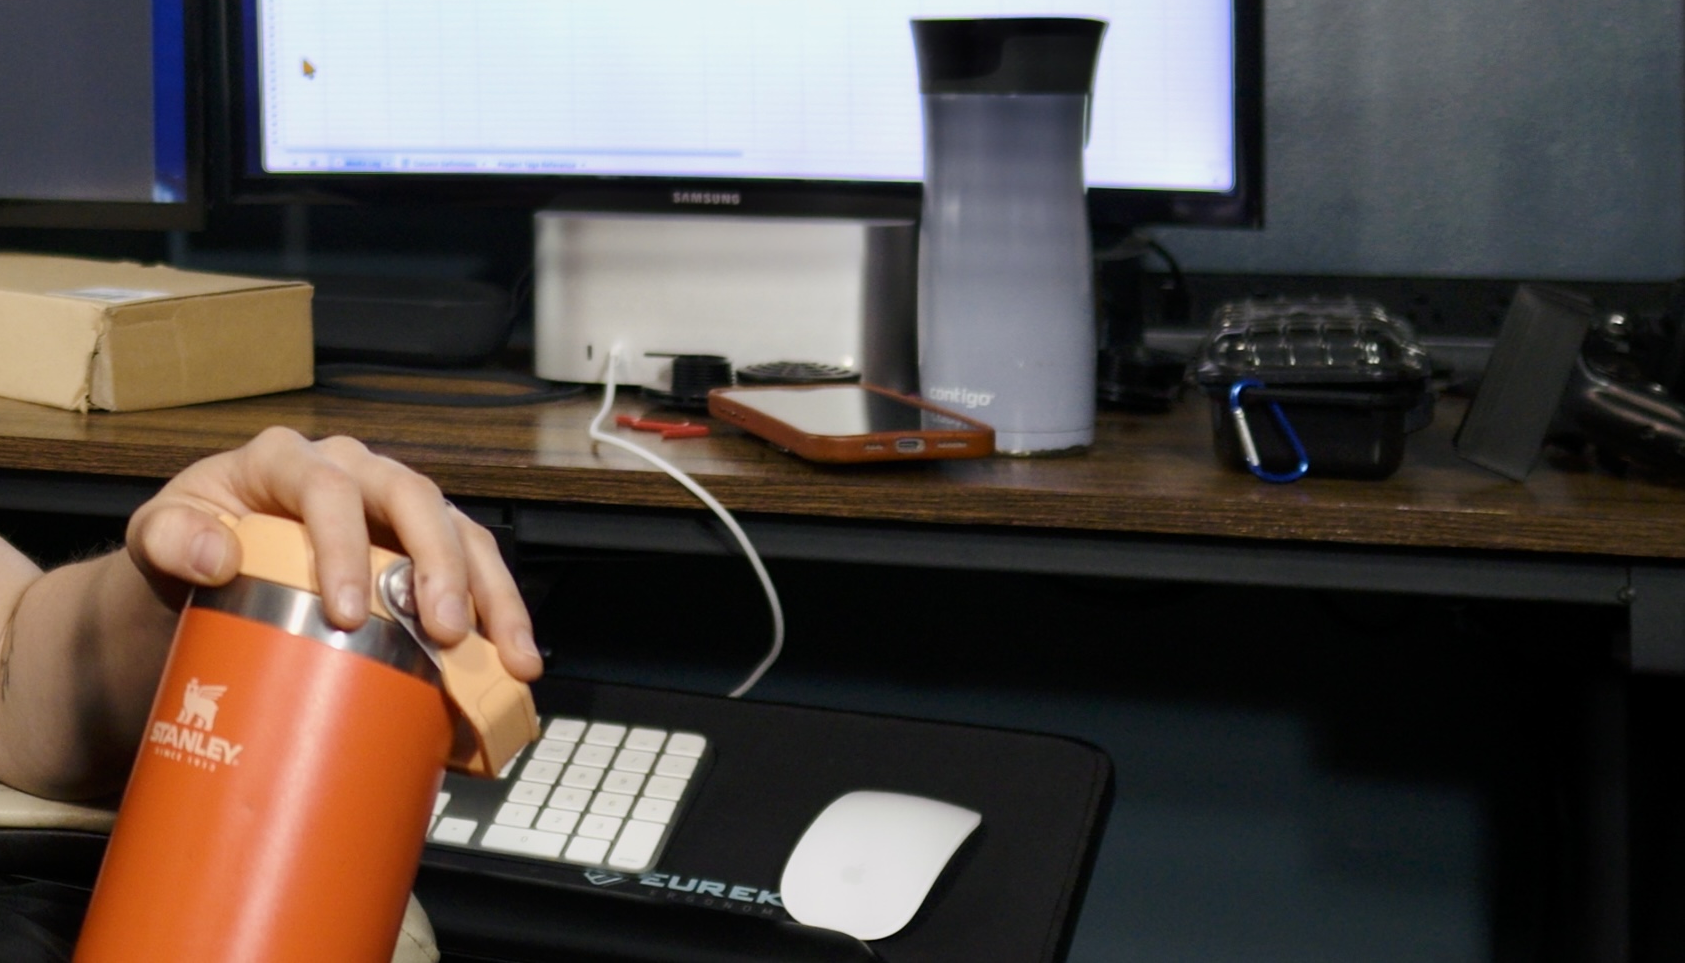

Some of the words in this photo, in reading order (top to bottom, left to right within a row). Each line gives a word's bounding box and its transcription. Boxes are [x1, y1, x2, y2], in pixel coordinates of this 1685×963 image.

[672, 191, 741, 205] SAMSUNG
[929, 385, 992, 409] contigo
[150, 721, 243, 766] STANLEY
